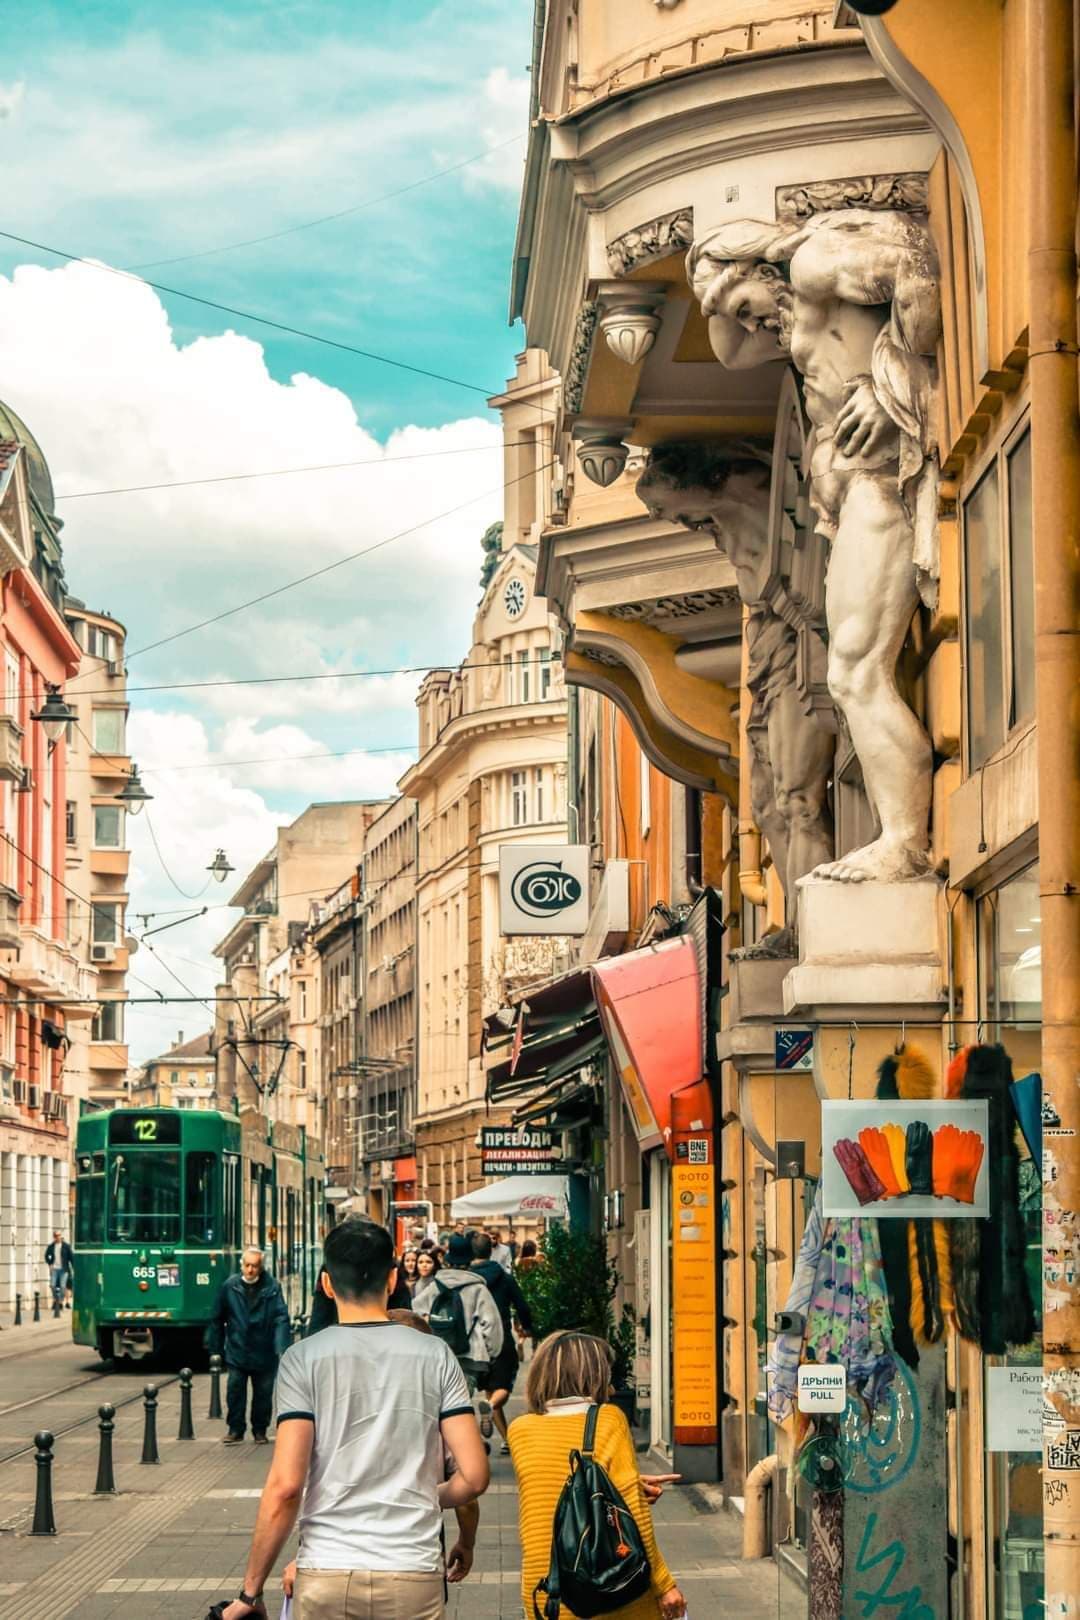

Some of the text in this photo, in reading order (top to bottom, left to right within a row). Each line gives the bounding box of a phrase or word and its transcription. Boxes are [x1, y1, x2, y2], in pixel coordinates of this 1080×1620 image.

[134, 1119, 157, 1140] 12
[690, 1141, 707, 1151] BNE
[678, 1172, 709, 1181] ФОТО
[132, 1266, 156, 1278] 665
[802, 1377, 843, 1386] ДРЪПНИ
[810, 1391, 835, 1400] PULL
[679, 1412, 711, 1421] ФОТО
